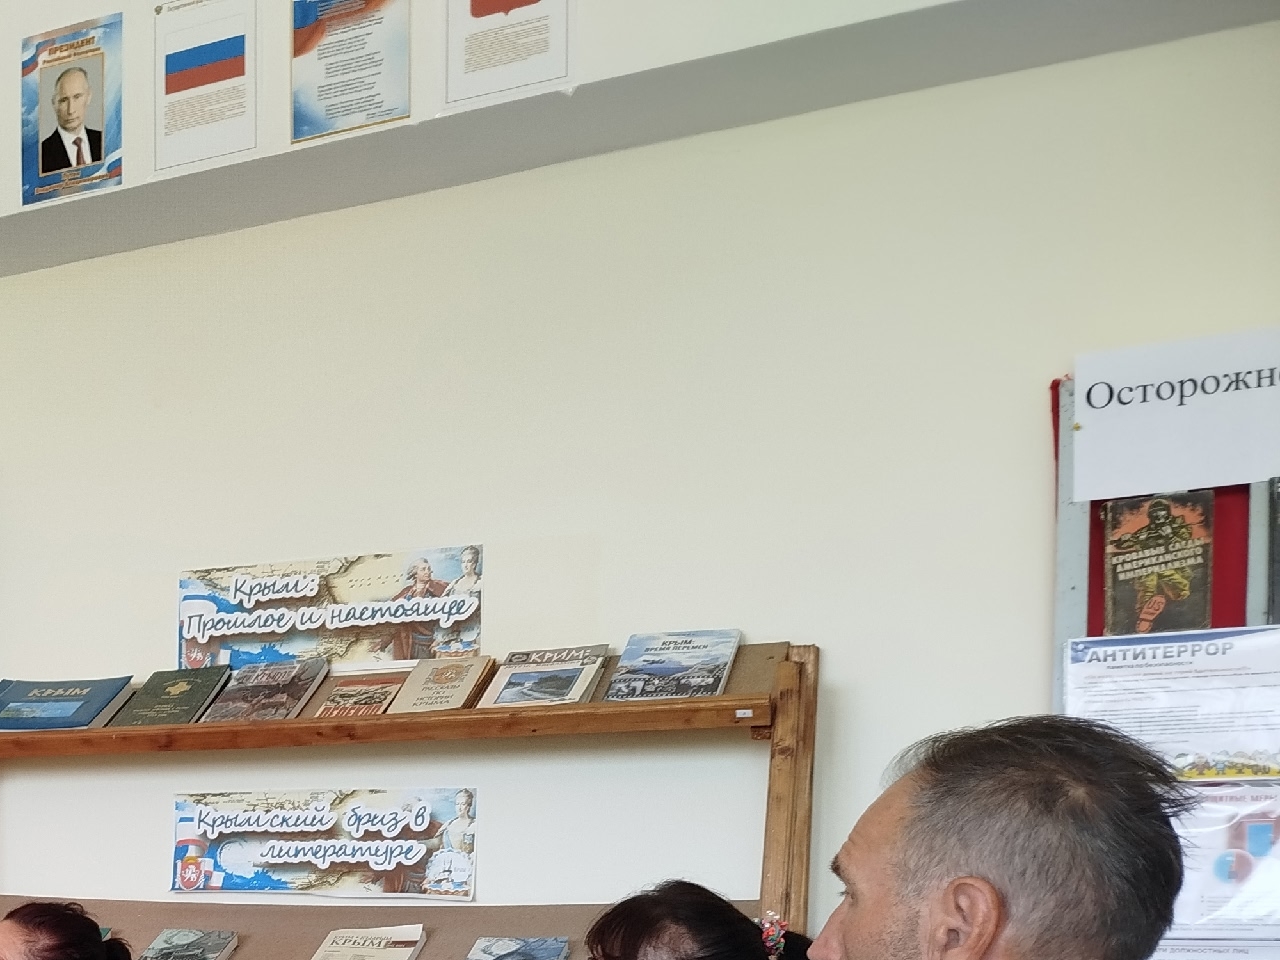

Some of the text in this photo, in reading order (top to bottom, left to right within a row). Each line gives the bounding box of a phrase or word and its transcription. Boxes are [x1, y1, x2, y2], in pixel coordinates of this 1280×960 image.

[1085, 366, 1280, 410] Осторожн
[1116, 546, 1203, 573] АМЕРИКАНСКОГО
[1118, 556, 1204, 581] ИМПЕРИАЛИЗМА
[233, 576, 317, 602] Крым:
[187, 611, 292, 638] Прошлое
[301, 612, 323, 626] и
[1086, 642, 1234, 664] АНТИТЕРРОР
[28, 687, 91, 697] КРЫМ
[197, 805, 426, 834] Крымский бриз в
[260, 842, 421, 865] литературе
[329, 939, 383, 948] КРЫМ
